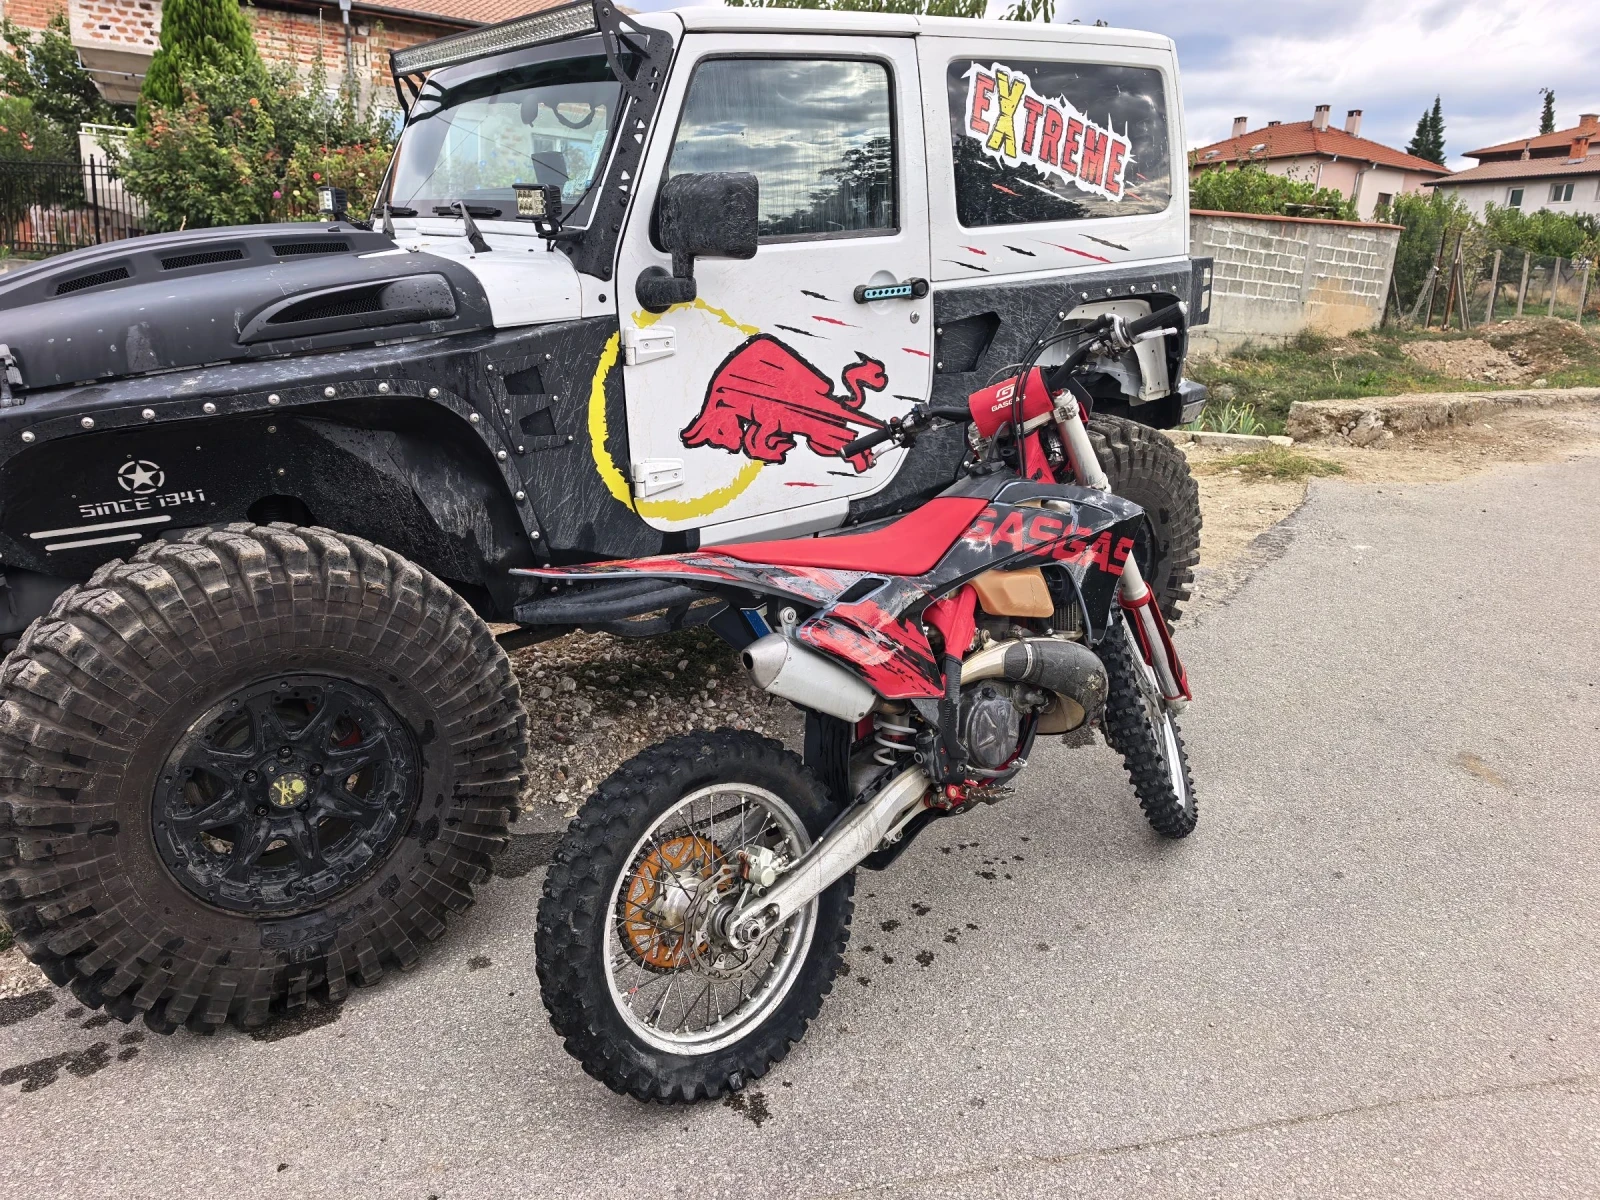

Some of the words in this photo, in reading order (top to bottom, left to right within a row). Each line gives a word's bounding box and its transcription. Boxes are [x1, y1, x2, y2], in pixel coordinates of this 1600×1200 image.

[969, 68, 1127, 197] EXTREME
[78, 497, 152, 518] SINCE
[156, 488, 206, 508] 1941
[963, 507, 1135, 577] GASGAS
